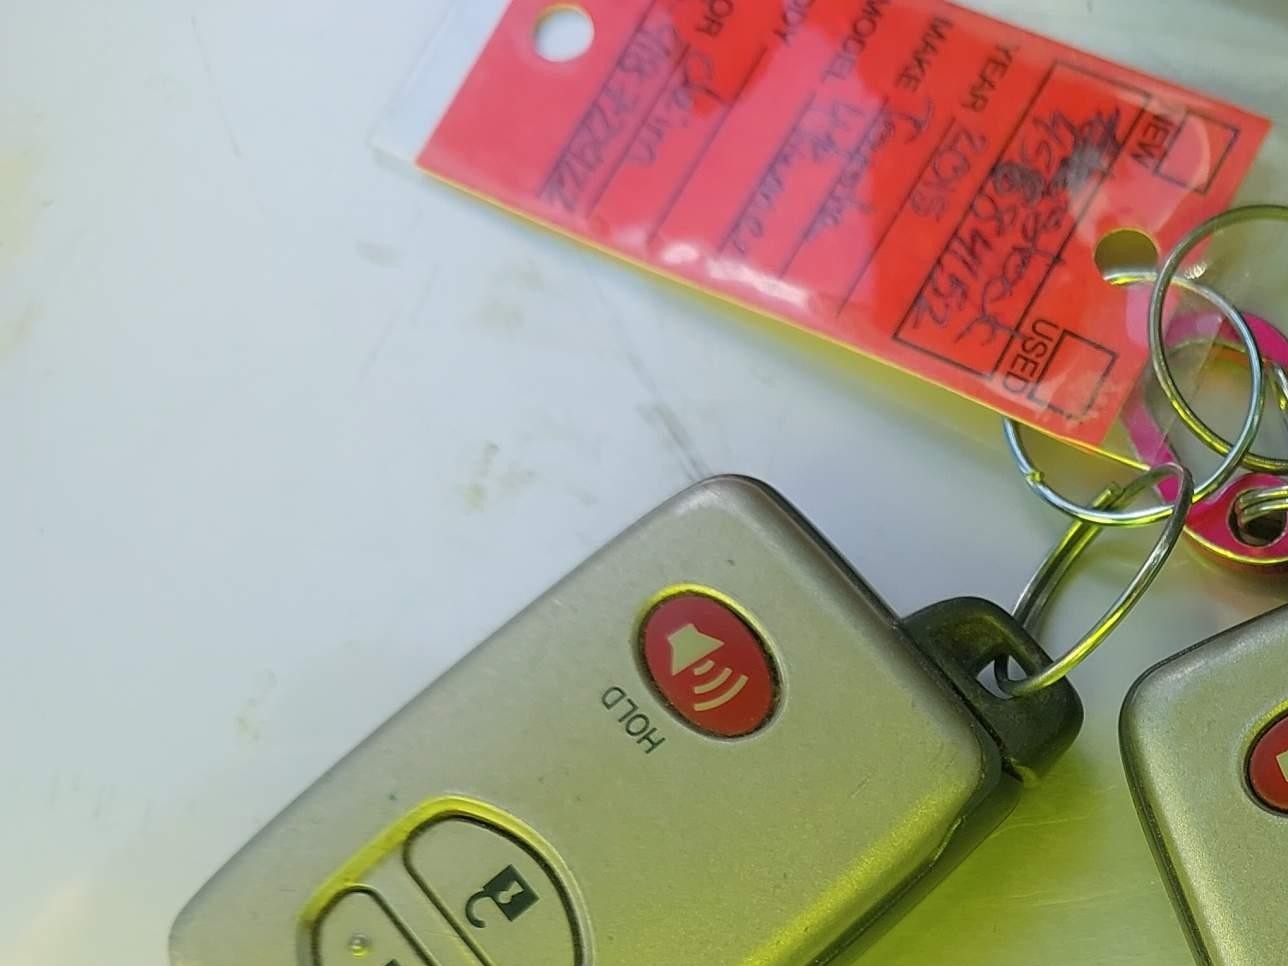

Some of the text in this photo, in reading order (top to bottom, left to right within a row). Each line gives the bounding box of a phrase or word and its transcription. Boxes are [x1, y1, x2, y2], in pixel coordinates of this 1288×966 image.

[895, 16, 954, 94] MAKE
[962, 45, 1019, 113] YEAR
[1002, 317, 1059, 394] USED
[601, 686, 666, 754] HOLD
